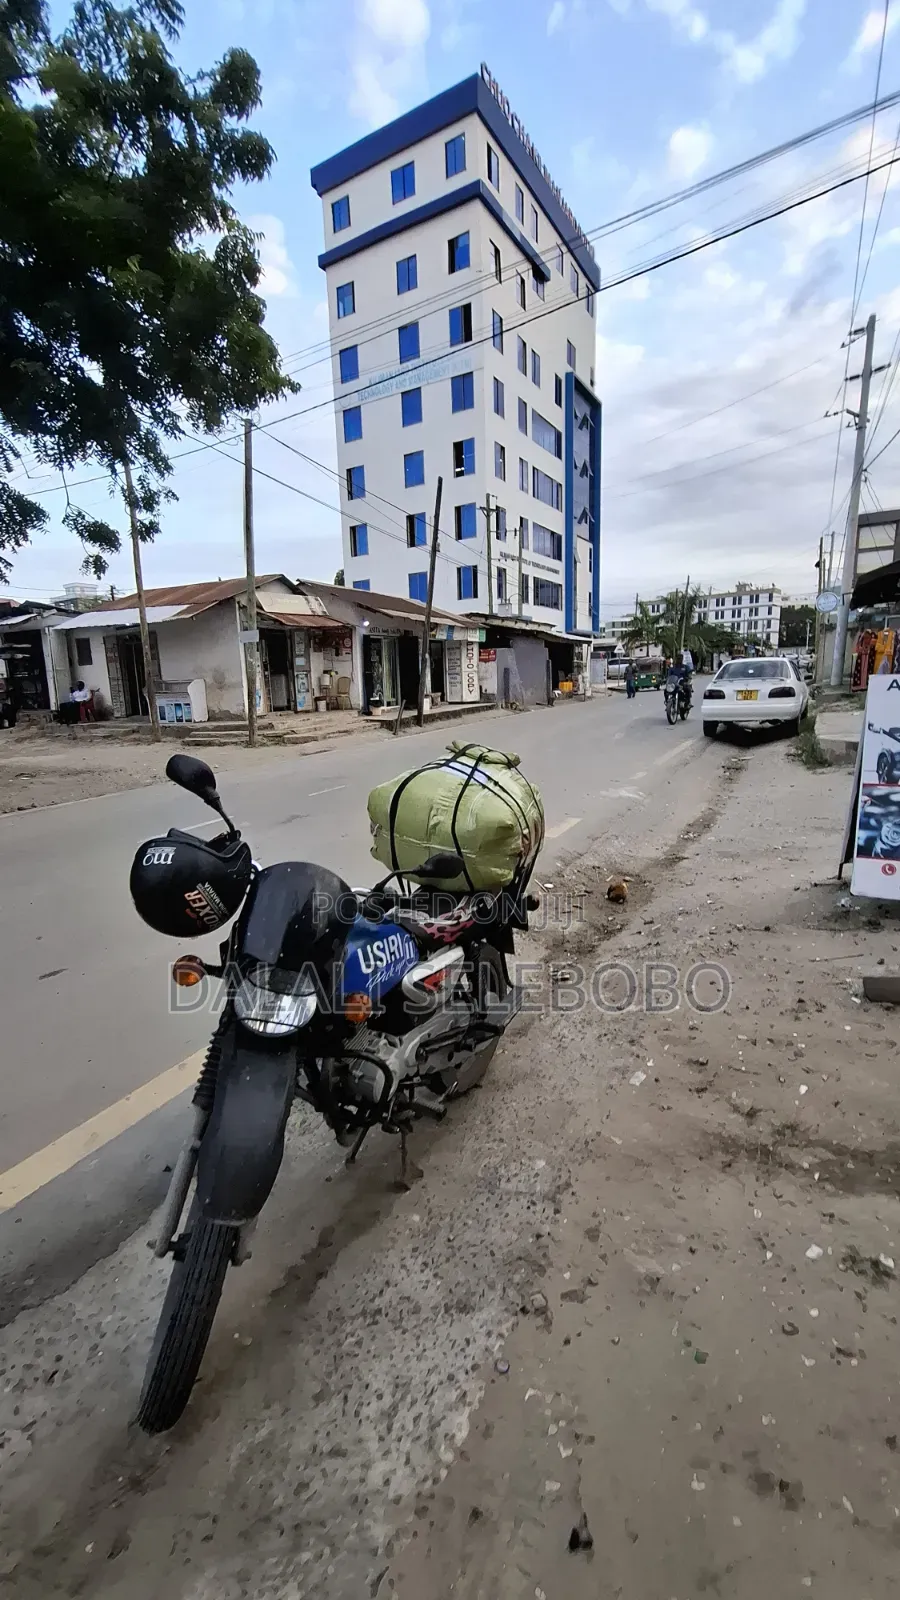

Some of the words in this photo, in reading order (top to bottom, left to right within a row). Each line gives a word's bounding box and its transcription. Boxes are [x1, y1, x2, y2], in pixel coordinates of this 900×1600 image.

[466, 641, 474, 669] PHOTO
[467, 672, 475, 695] COPY
[357, 932, 404, 974] USIRI
